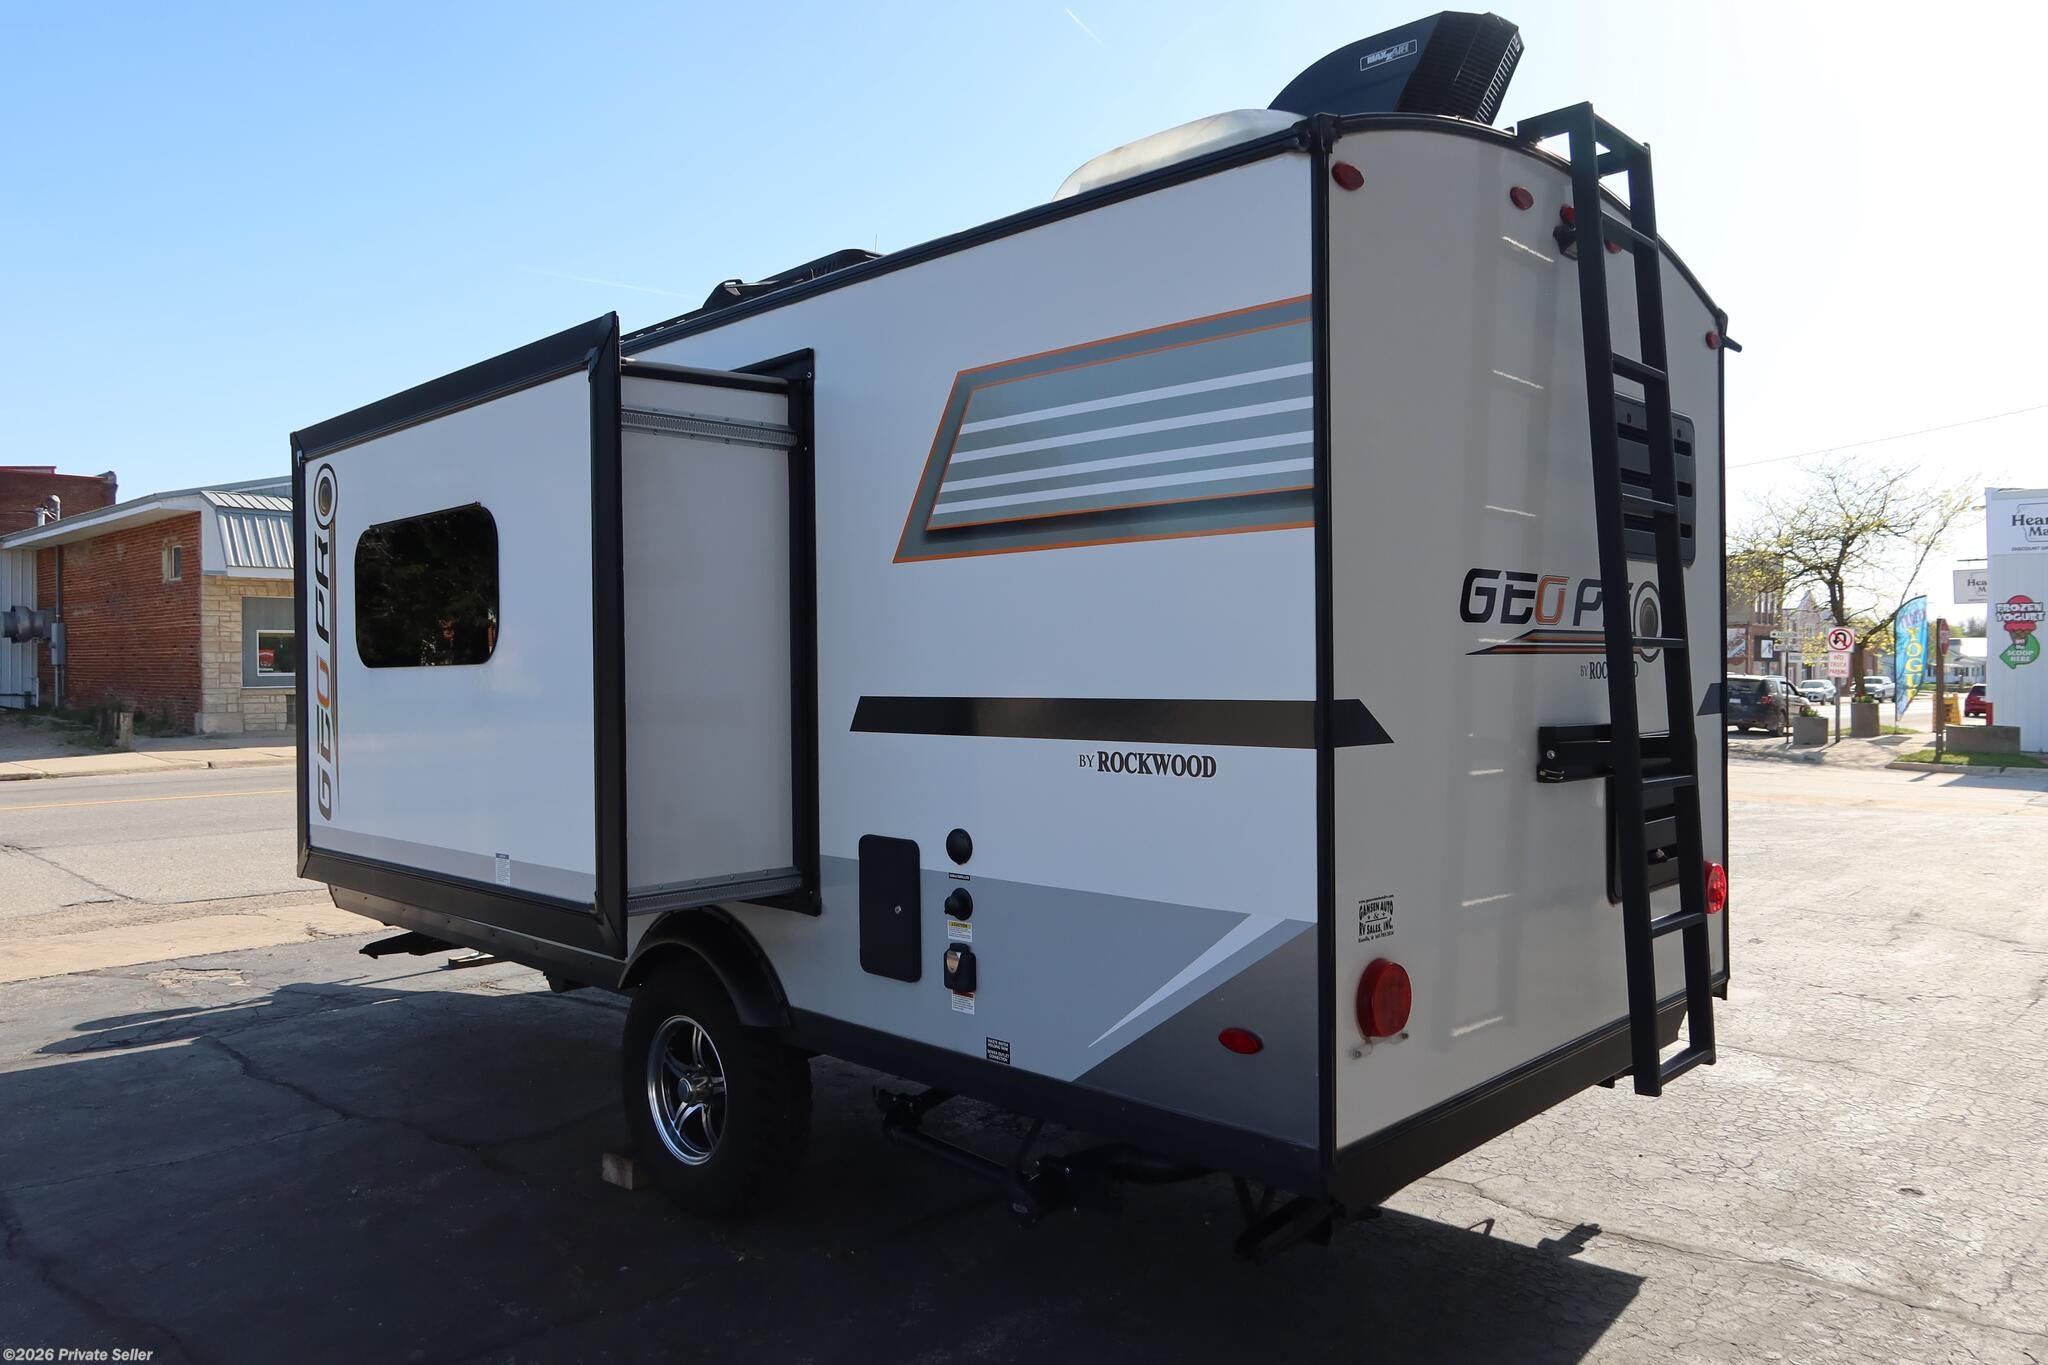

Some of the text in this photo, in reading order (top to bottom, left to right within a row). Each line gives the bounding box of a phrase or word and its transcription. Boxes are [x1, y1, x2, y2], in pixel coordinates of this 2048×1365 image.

[1459, 568, 1662, 663] GEO PO
[1996, 602, 2044, 612] FROZEN
[1996, 611, 2046, 622] YOGURT
[1589, 662, 1639, 680] ROCD
[316, 655, 332, 821] GEO
[1079, 750, 1217, 778] BY ROCKWOOD
[1359, 900, 1393, 920] GANSEN AUTO
[1359, 921, 1366, 937] RV
